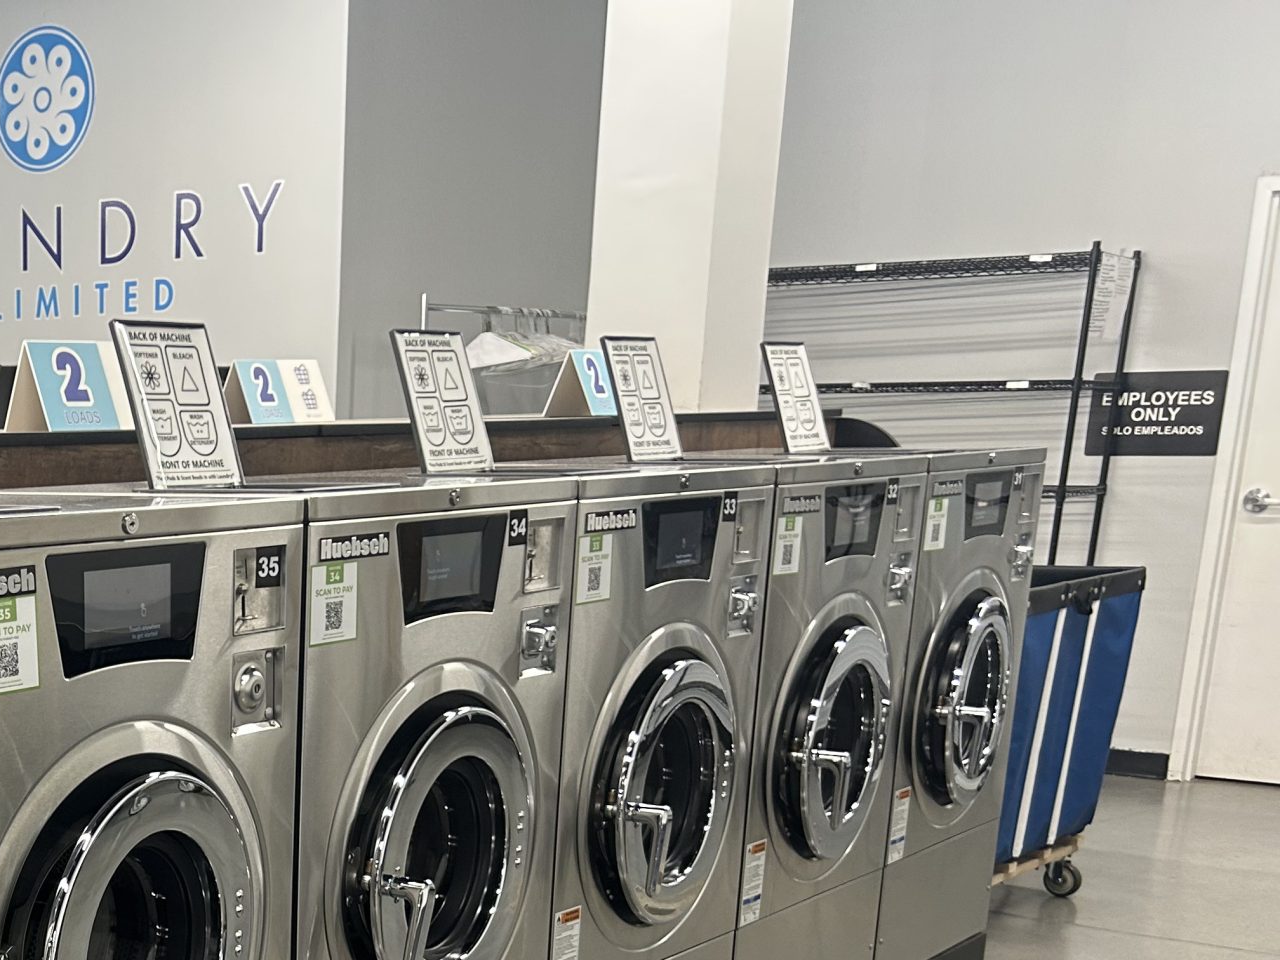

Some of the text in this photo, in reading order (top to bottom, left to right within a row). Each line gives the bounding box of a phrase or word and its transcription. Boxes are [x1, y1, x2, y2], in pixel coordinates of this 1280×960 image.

[128, 331, 192, 343] BACK OF MACHINE
[55, 349, 92, 403] 2
[585, 357, 607, 394] 2
[251, 365, 277, 403] 2
[1102, 390, 1215, 406] EMPLOYEES
[65, 411, 102, 424] LOADS
[1130, 407, 1181, 421] ONLY
[1100, 426, 1204, 435] SLO EMPLEADOS
[161, 459, 224, 469] RONT OF MACHINE
[888, 484, 898, 499] 32
[723, 498, 736, 515] 33
[510, 518, 527, 537] 34
[586, 509, 636, 531] Huebsch
[320, 533, 389, 560] Huebsch
[257, 555, 280, 578] 35
[329, 571, 340, 582] 34
[315, 585, 354, 597] SCAN TO PAY
[3, 626, 14, 636] TO
[15, 623, 32, 634] PAY
